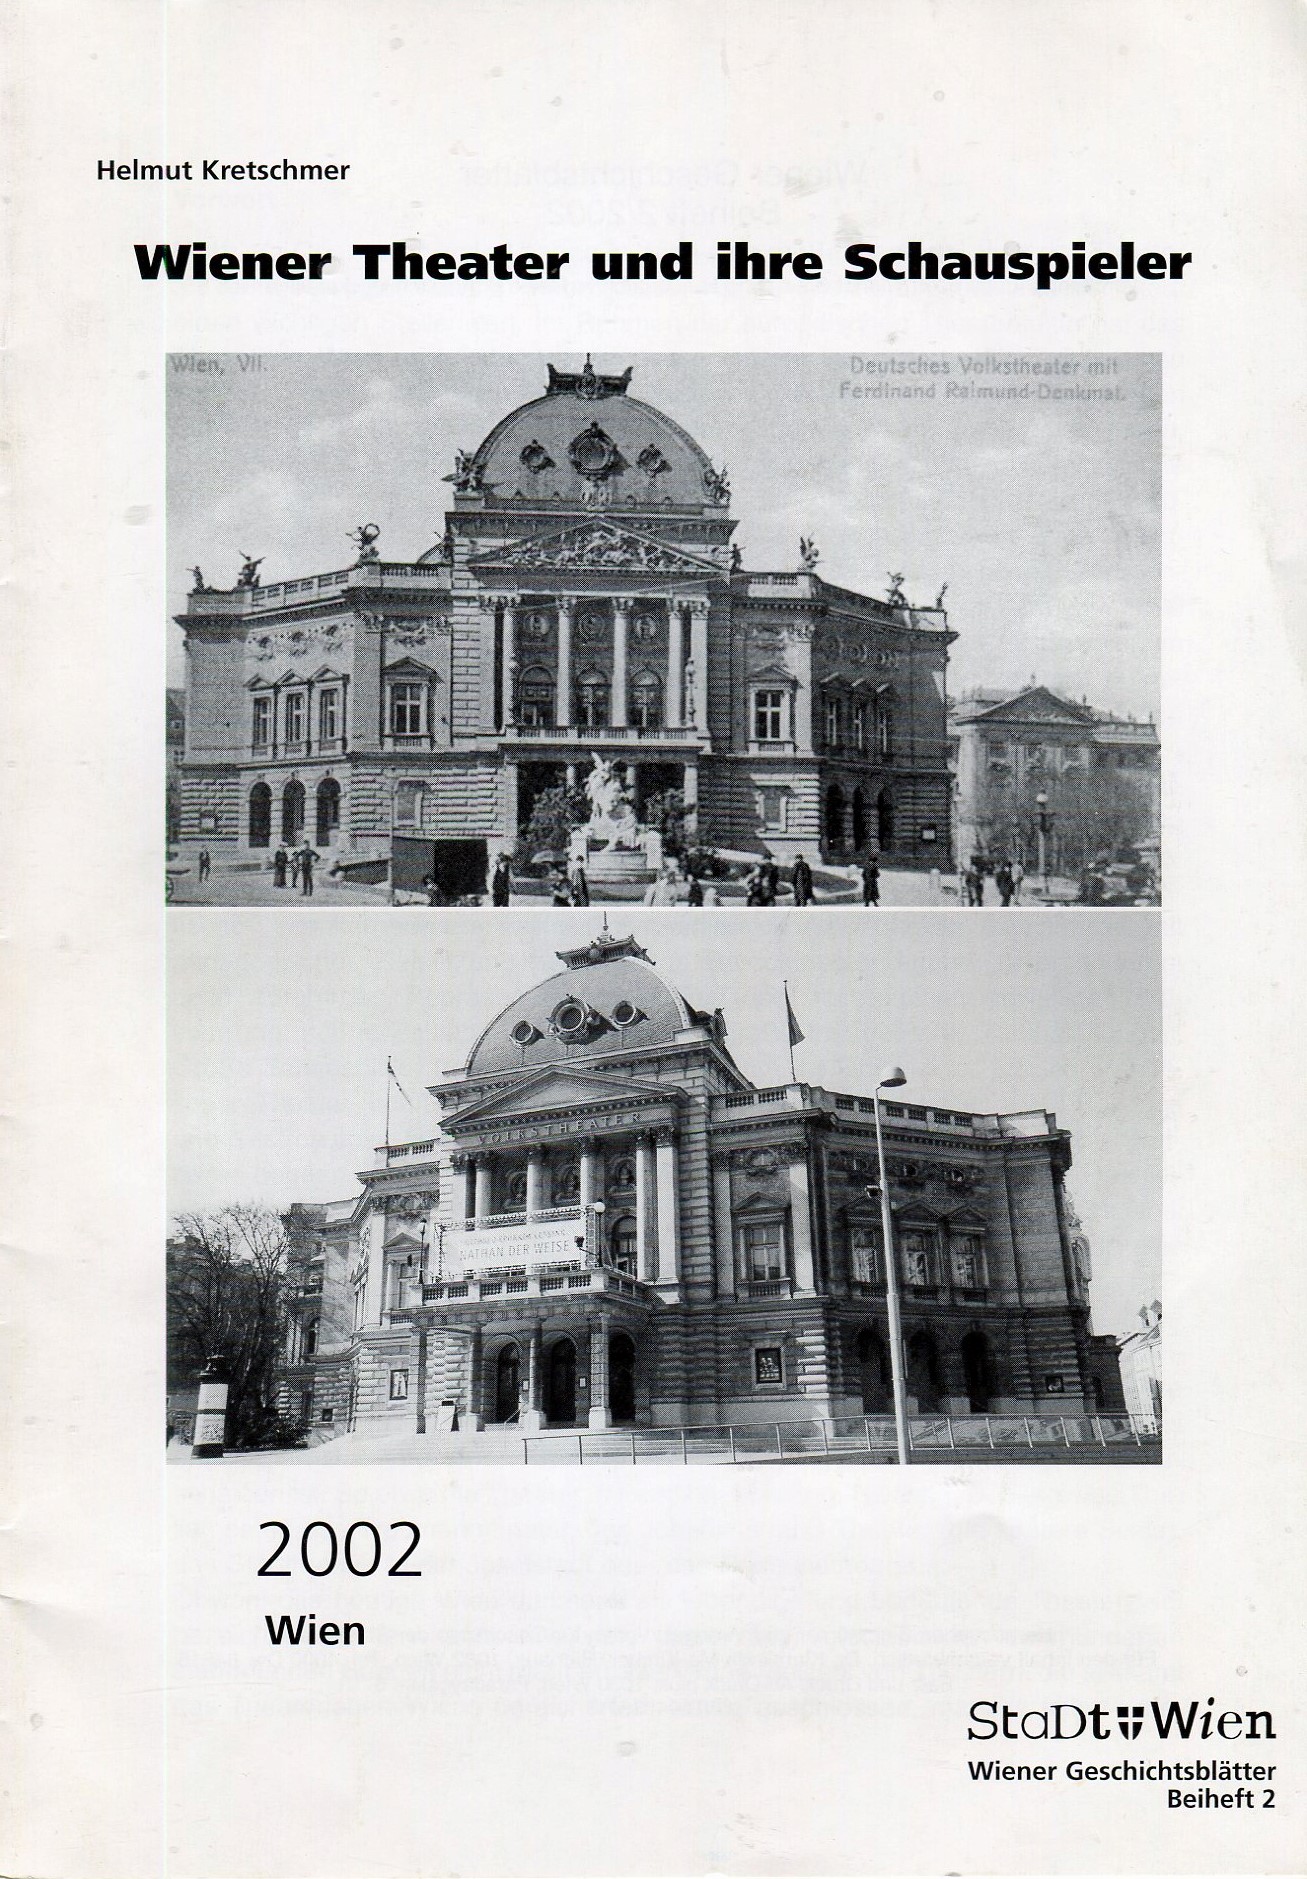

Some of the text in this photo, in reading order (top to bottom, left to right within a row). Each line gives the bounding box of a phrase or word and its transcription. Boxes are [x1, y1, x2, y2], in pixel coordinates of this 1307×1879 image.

[97, 159, 351, 181] Helmut Kretschmer
[133, 241, 1193, 290] Wiener Theater und ihre Schauspieler
[170, 354, 268, 376] Wien, VII.
[850, 355, 1119, 376] Deutsches Volkstheater mit
[838, 380, 937, 400] Ferdinand
[478, 1111, 641, 1144] VOLKSTHEATER
[459, 1240, 570, 1261] NATHAN DER WEISE
[257, 1521, 422, 1577] 2002
[264, 1613, 365, 1646] Wien
[1150, 1696, 1277, 1740] Wien
[967, 1759, 1277, 1781] Wiener Geschichtsblätter
[1168, 1787, 1275, 1809] Beiheft 2
